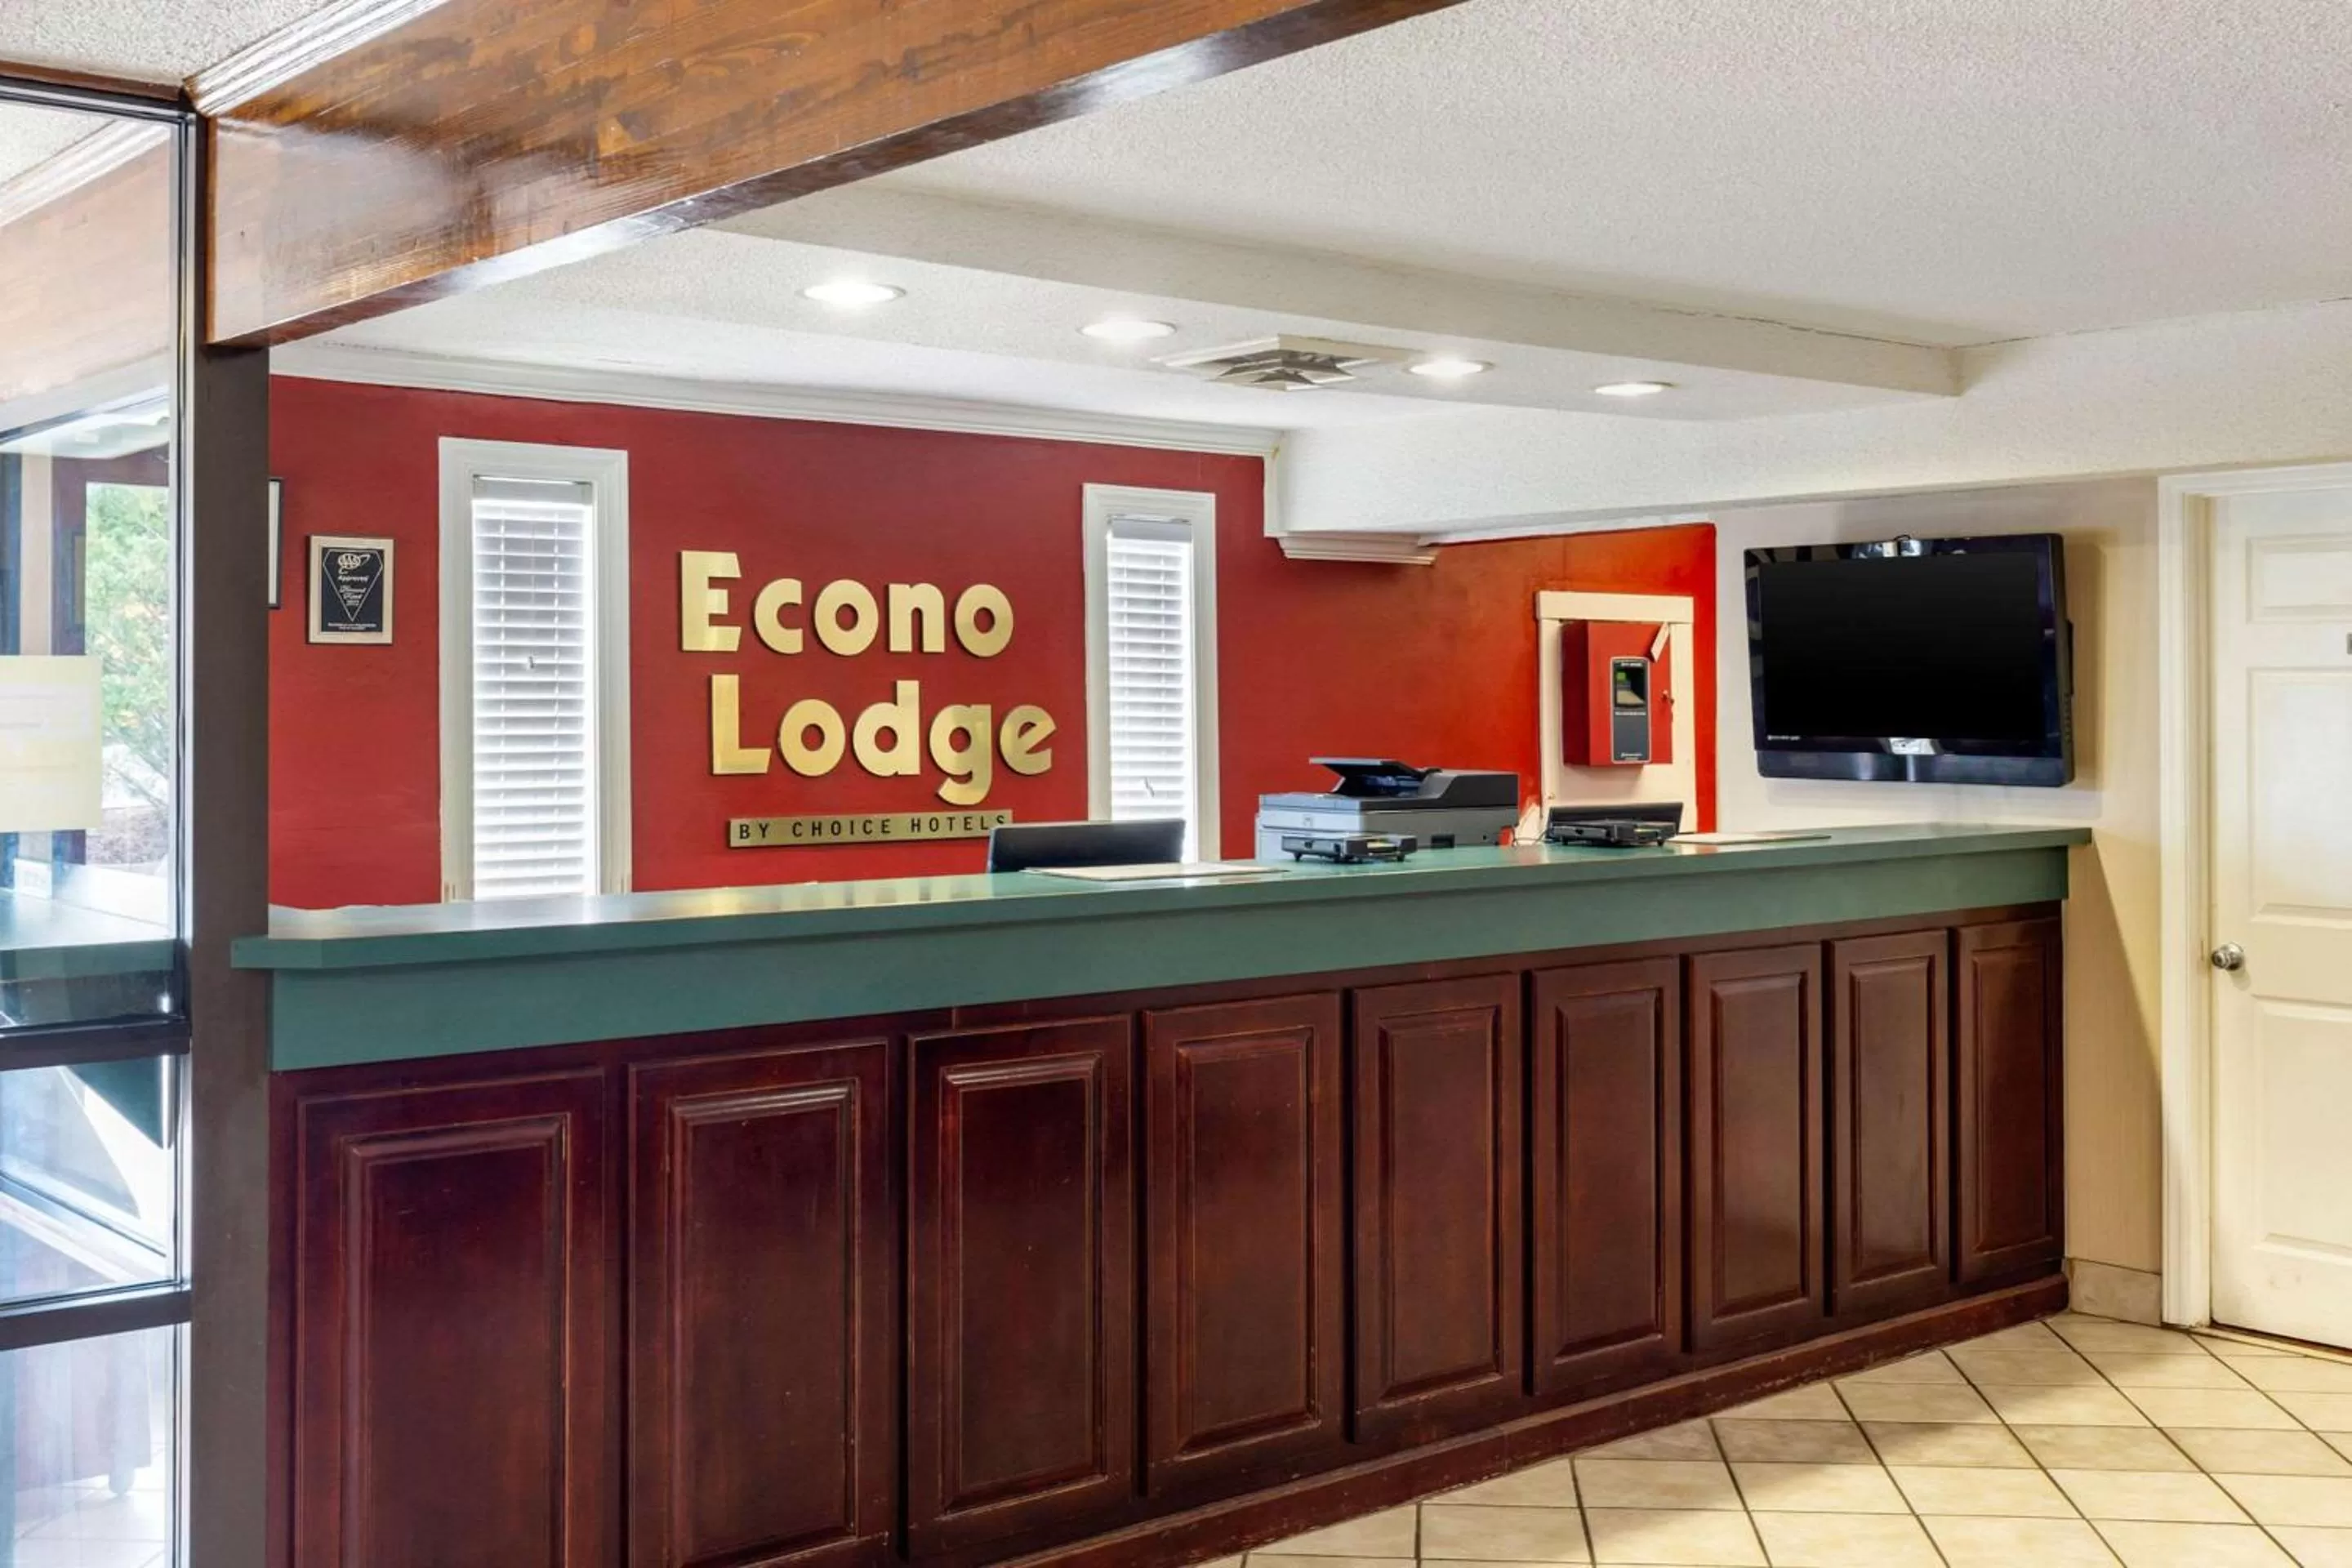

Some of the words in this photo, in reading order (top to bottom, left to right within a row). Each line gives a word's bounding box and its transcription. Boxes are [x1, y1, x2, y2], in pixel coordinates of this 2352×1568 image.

[681, 550, 1013, 657] Econo
[711, 674, 1057, 806] Lodge
[739, 822, 770, 840] BY
[791, 818, 892, 838] CHOICE
[911, 814, 1005, 833] HOTELS
